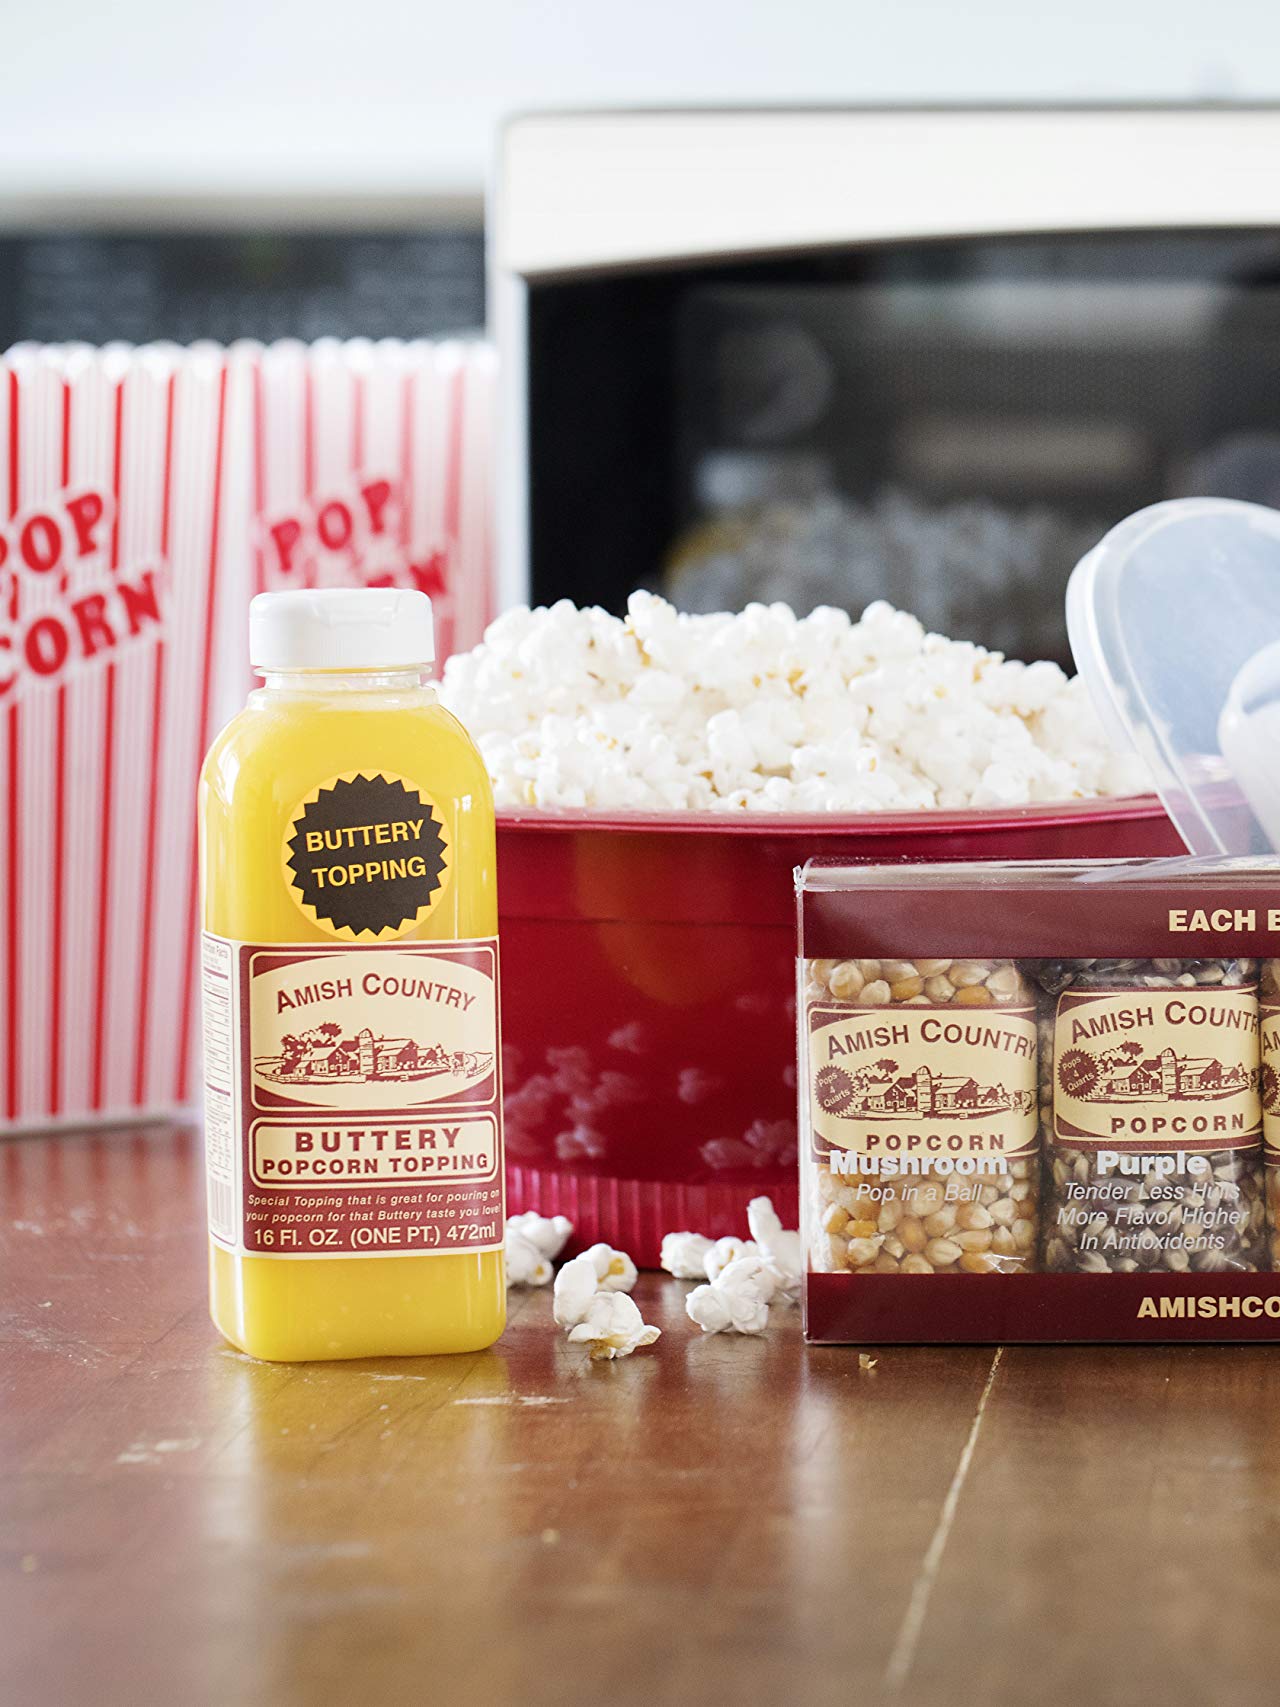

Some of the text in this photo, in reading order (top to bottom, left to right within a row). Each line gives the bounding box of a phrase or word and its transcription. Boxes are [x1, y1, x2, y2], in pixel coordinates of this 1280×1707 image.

[0, 493, 103, 572] OP
[271, 480, 392, 574] POP
[305, 819, 424, 852] BUTTERY
[311, 856, 426, 888] TOPPING
[1168, 909, 1256, 932] EACH
[276, 973, 476, 1014] AMISH COUNTRY
[1071, 1000, 1258, 1044] AMISH COUNTR
[828, 1018, 1037, 1061] AMISH COUNTRY
[1062, 1056, 1081, 1071] Pops
[818, 1072, 838, 1088] Pops
[1067, 1072, 1095, 1091] Quarts
[823, 1089, 851, 1108] Quarts
[1111, 1113, 1244, 1134] POPCORN
[295, 1127, 462, 1152] BUTTERY
[866, 1134, 1005, 1151] POPCORN
[262, 1153, 488, 1175] POPCORN TOPPING
[829, 1150, 1008, 1175] Mushroom
[1097, 1150, 1209, 1179] Purple
[248, 1195, 289, 1206] Special
[294, 1196, 343, 1208] Topping
[347, 1195, 371, 1205] that
[376, 1195, 387, 1204] is
[390, 1194, 422, 1206] great
[426, 1193, 443, 1203] for
[446, 1190, 488, 1204] pouring
[856, 1184, 983, 1205] Pop in a Ball
[1065, 1182, 1241, 1200] Tender Less Hulls
[246, 1212, 269, 1222] your
[272, 1213, 323, 1224] popcorn
[328, 1212, 345, 1222] for
[349, 1211, 374, 1221] that
[378, 1210, 422, 1221] Buttery
[426, 1209, 456, 1219] taste
[459, 1208, 479, 1219] you
[1056, 1207, 1249, 1229] More Flavor Higher
[254, 1228, 275, 1245] 16
[309, 1229, 343, 1246] OZ.
[350, 1227, 401, 1248] (ONE
[407, 1225, 440, 1246] PT.)
[446, 1221, 496, 1240] 472ml
[1080, 1233, 1225, 1250] In Antioxidents
